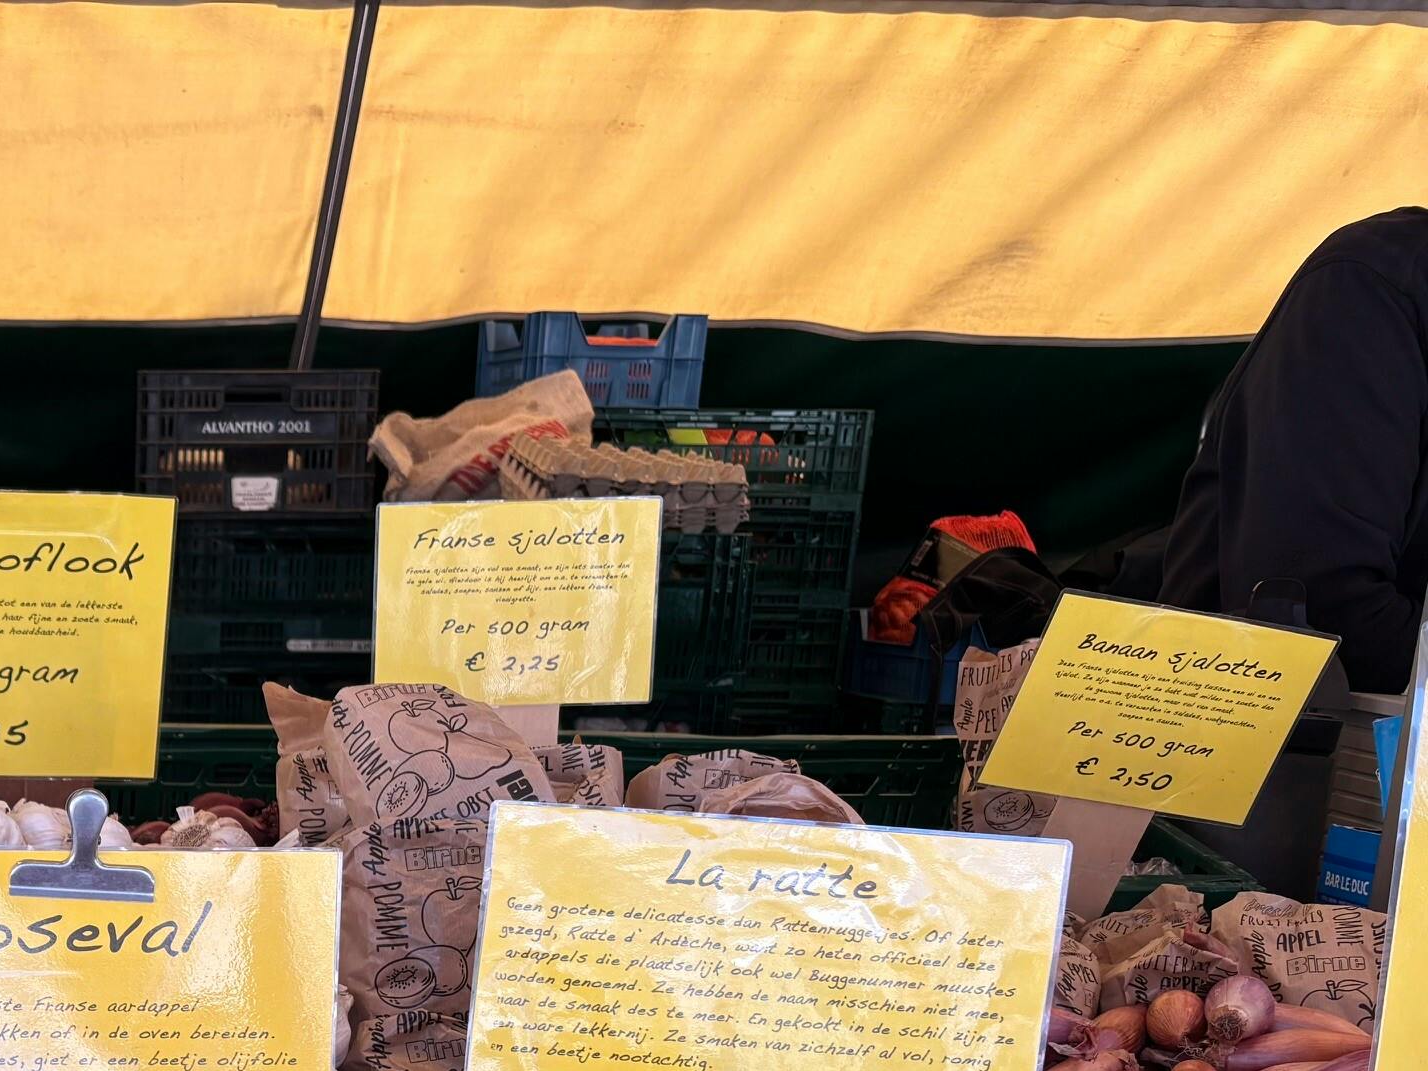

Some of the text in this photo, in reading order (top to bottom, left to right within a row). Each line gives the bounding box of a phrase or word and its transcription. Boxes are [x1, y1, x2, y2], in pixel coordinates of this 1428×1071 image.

[202, 420, 311, 434] ALVANTHO 2001
[413, 526, 626, 555] Franse sjalotten
[60, 600, 72, 608] de
[441, 618, 590, 640] Per 500 gram
[464, 652, 560, 675] € 2,25
[1077, 632, 1283, 683] Banaan sjalotten
[1068, 721, 1214, 759] Per 500 gram
[344, 720, 392, 791] POMME
[1075, 758, 1173, 792] € 2,50
[666, 849, 879, 899] La ratte
[367, 881, 409, 952] POMME
[507, 896, 1004, 949] Geen grotere delicatesse dan Rattenruggejes. Of beter
[1277, 929, 1327, 953] APPEL
[1286, 955, 1366, 976] Birne
[33, 996, 98, 1013] Franse
[107, 999, 199, 1016] aardappel
[50, 1025, 76, 1039] of
[82, 1026, 99, 1039] in
[109, 1026, 129, 1039] de
[139, 1029, 180, 1039] oven
[190, 1024, 275, 1040] bereiden.
[32, 1052, 69, 1071] giet
[78, 1055, 98, 1066] er
[108, 1056, 139, 1066] een
[147, 1051, 208, 1071] beetje
[217, 1051, 298, 1071] olijfolie
[511, 1044, 539, 1054] een
[546, 1042, 602, 1064] beetje
